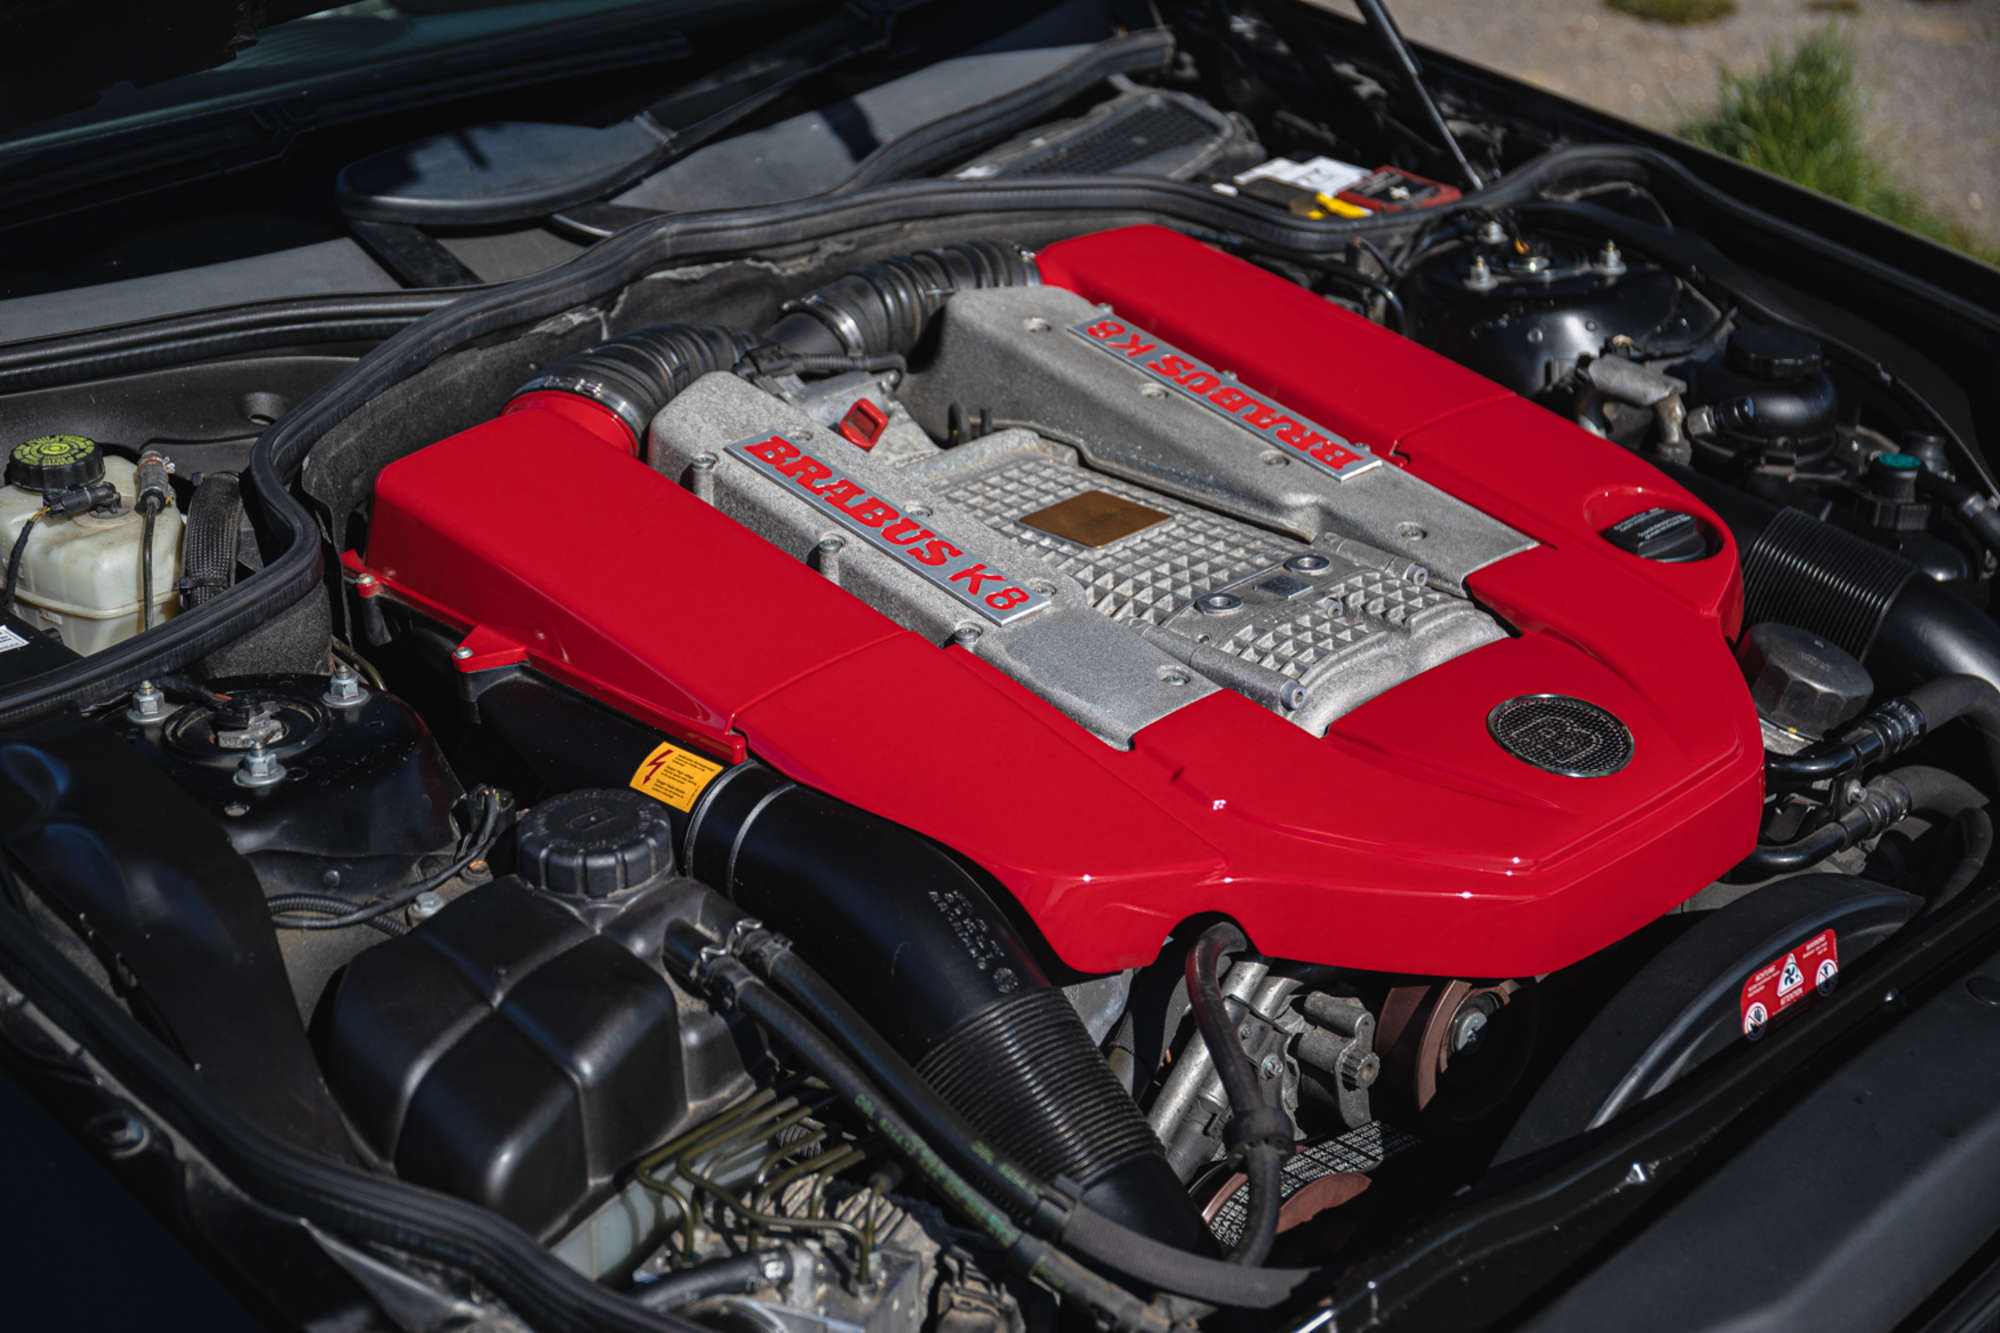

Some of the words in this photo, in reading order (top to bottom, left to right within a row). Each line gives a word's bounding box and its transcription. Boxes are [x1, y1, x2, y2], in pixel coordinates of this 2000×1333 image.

[1087, 320, 1156, 358] K8
[1147, 354, 1364, 470] BRABUS
[744, 435, 964, 567] BRABUS
[948, 563, 1030, 610] K8
